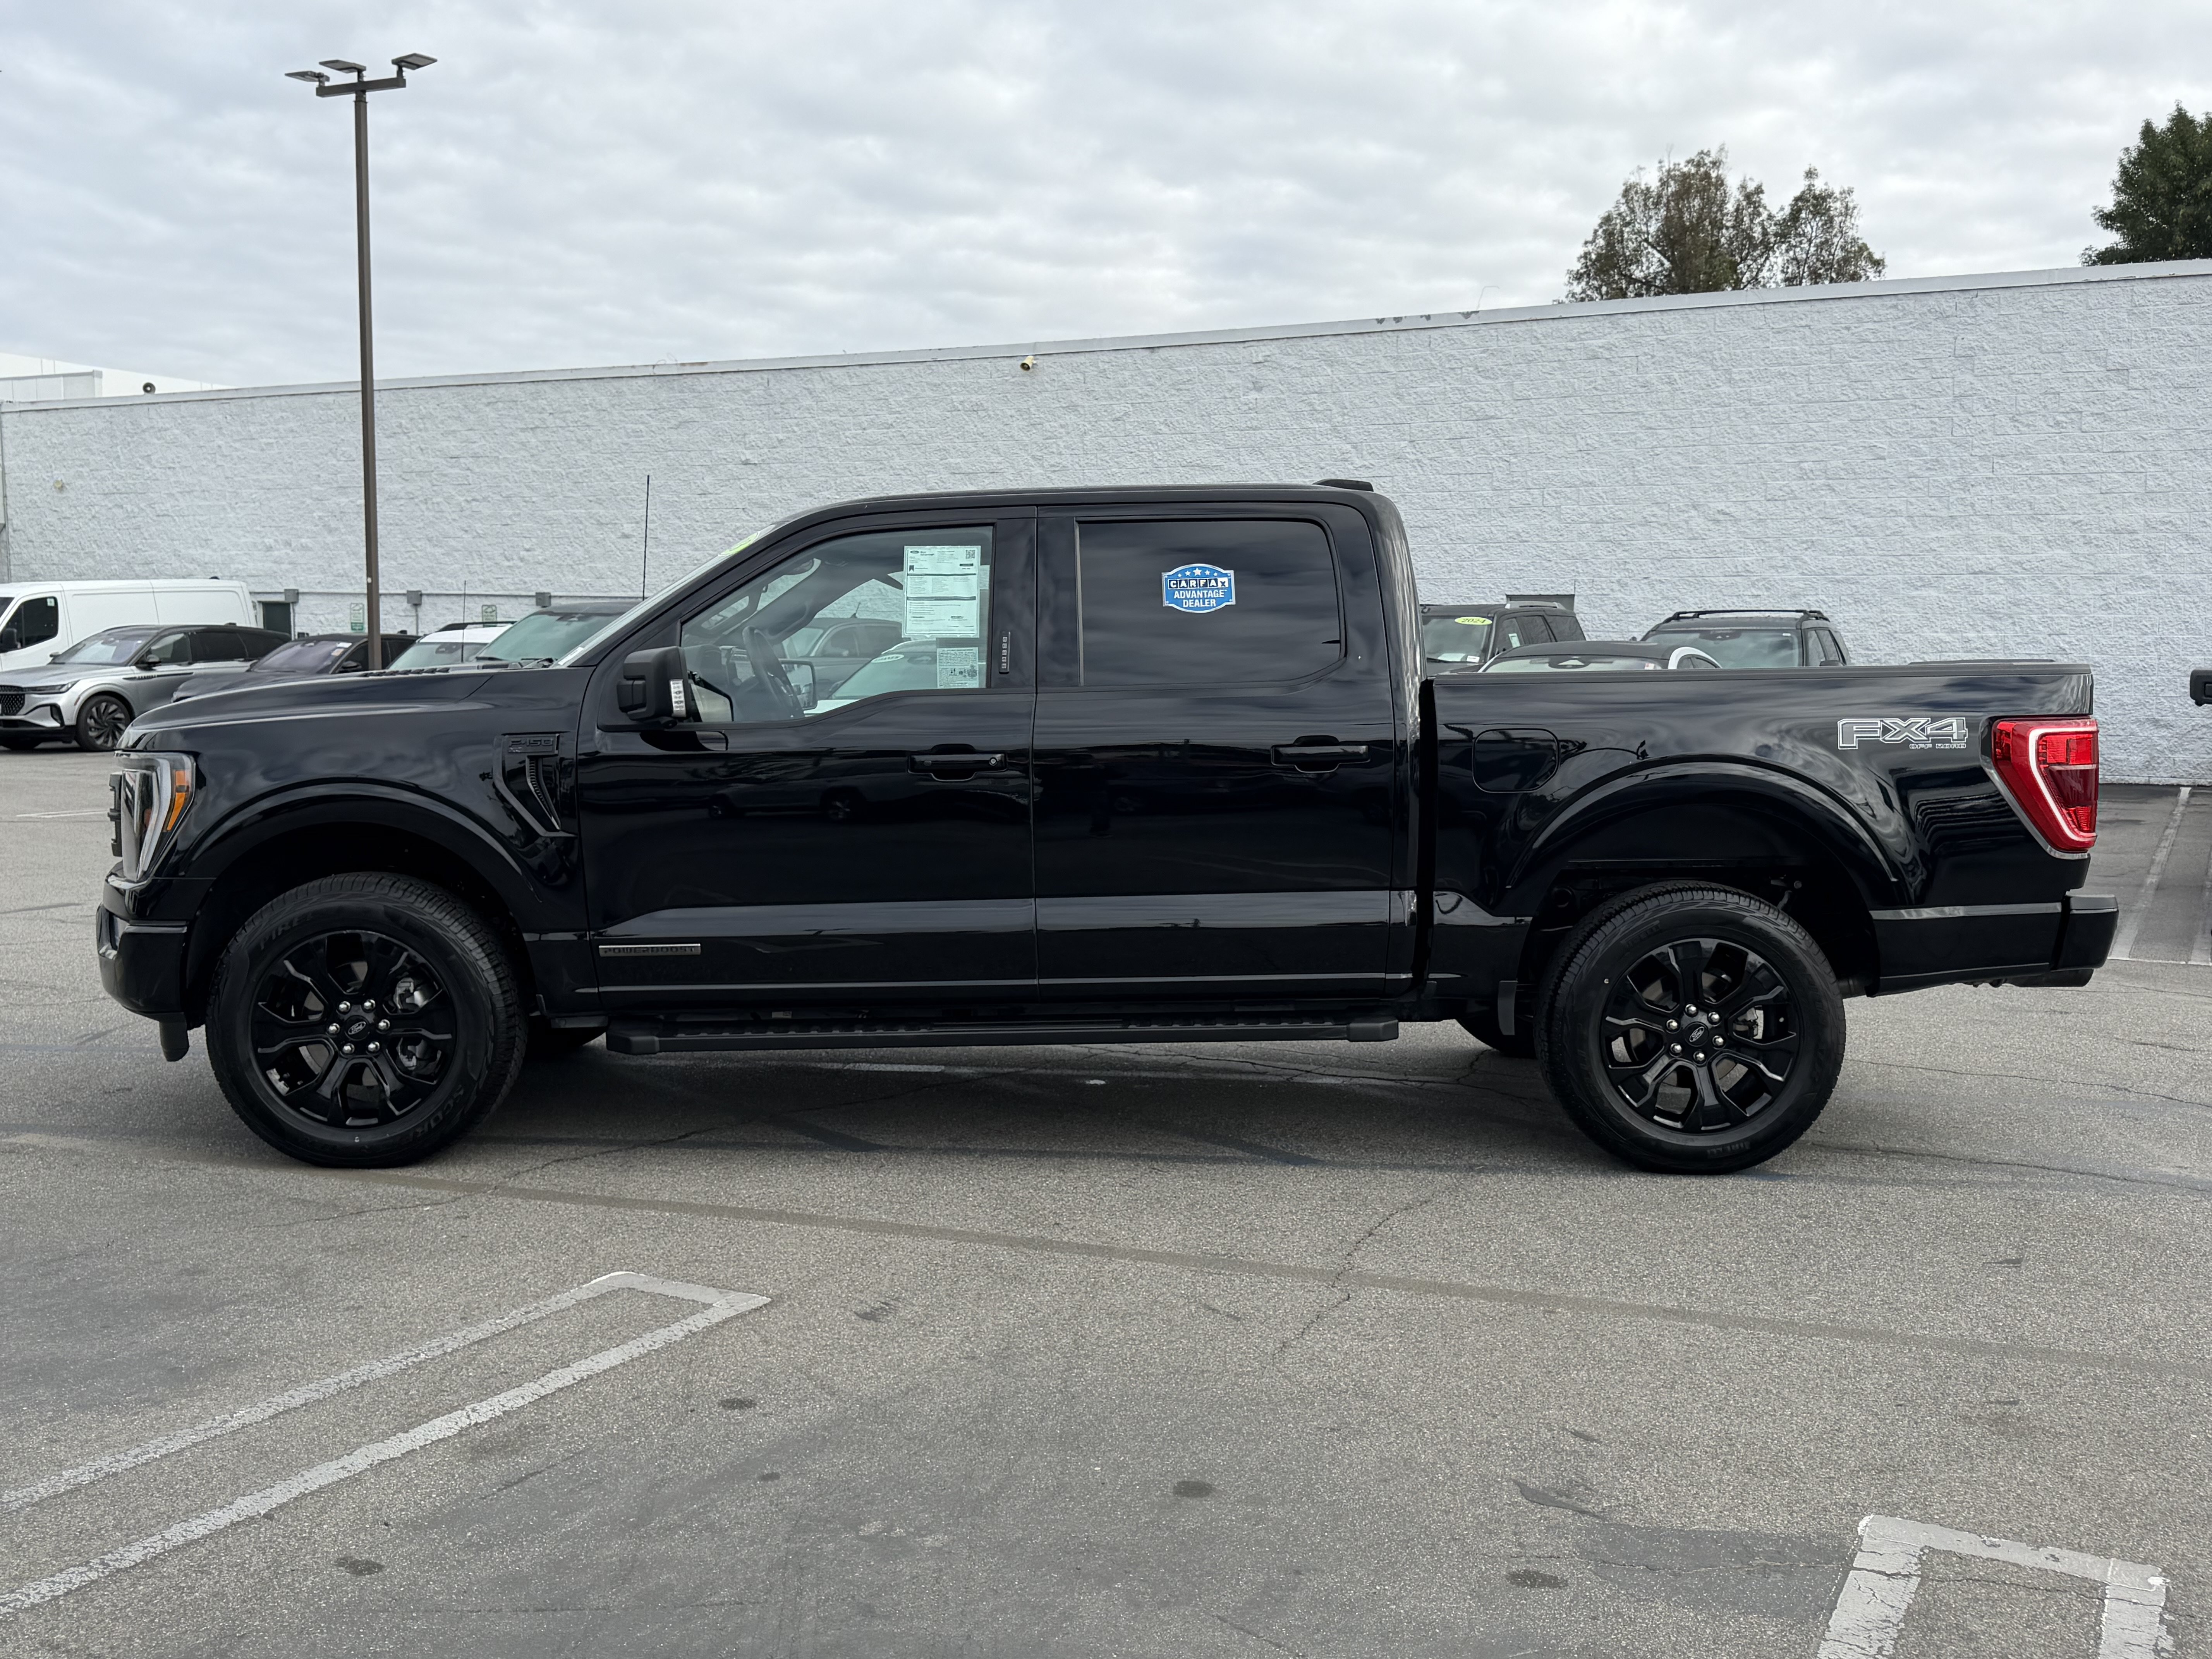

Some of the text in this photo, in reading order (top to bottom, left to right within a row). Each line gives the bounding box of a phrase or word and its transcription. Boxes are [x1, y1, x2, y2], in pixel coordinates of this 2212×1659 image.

[1169, 578, 1228, 589] CARFAX
[1174, 589, 1225, 599] ADVANTAGE
[1183, 599, 1216, 608] DEALER
[1837, 717, 1968, 750] FX4
